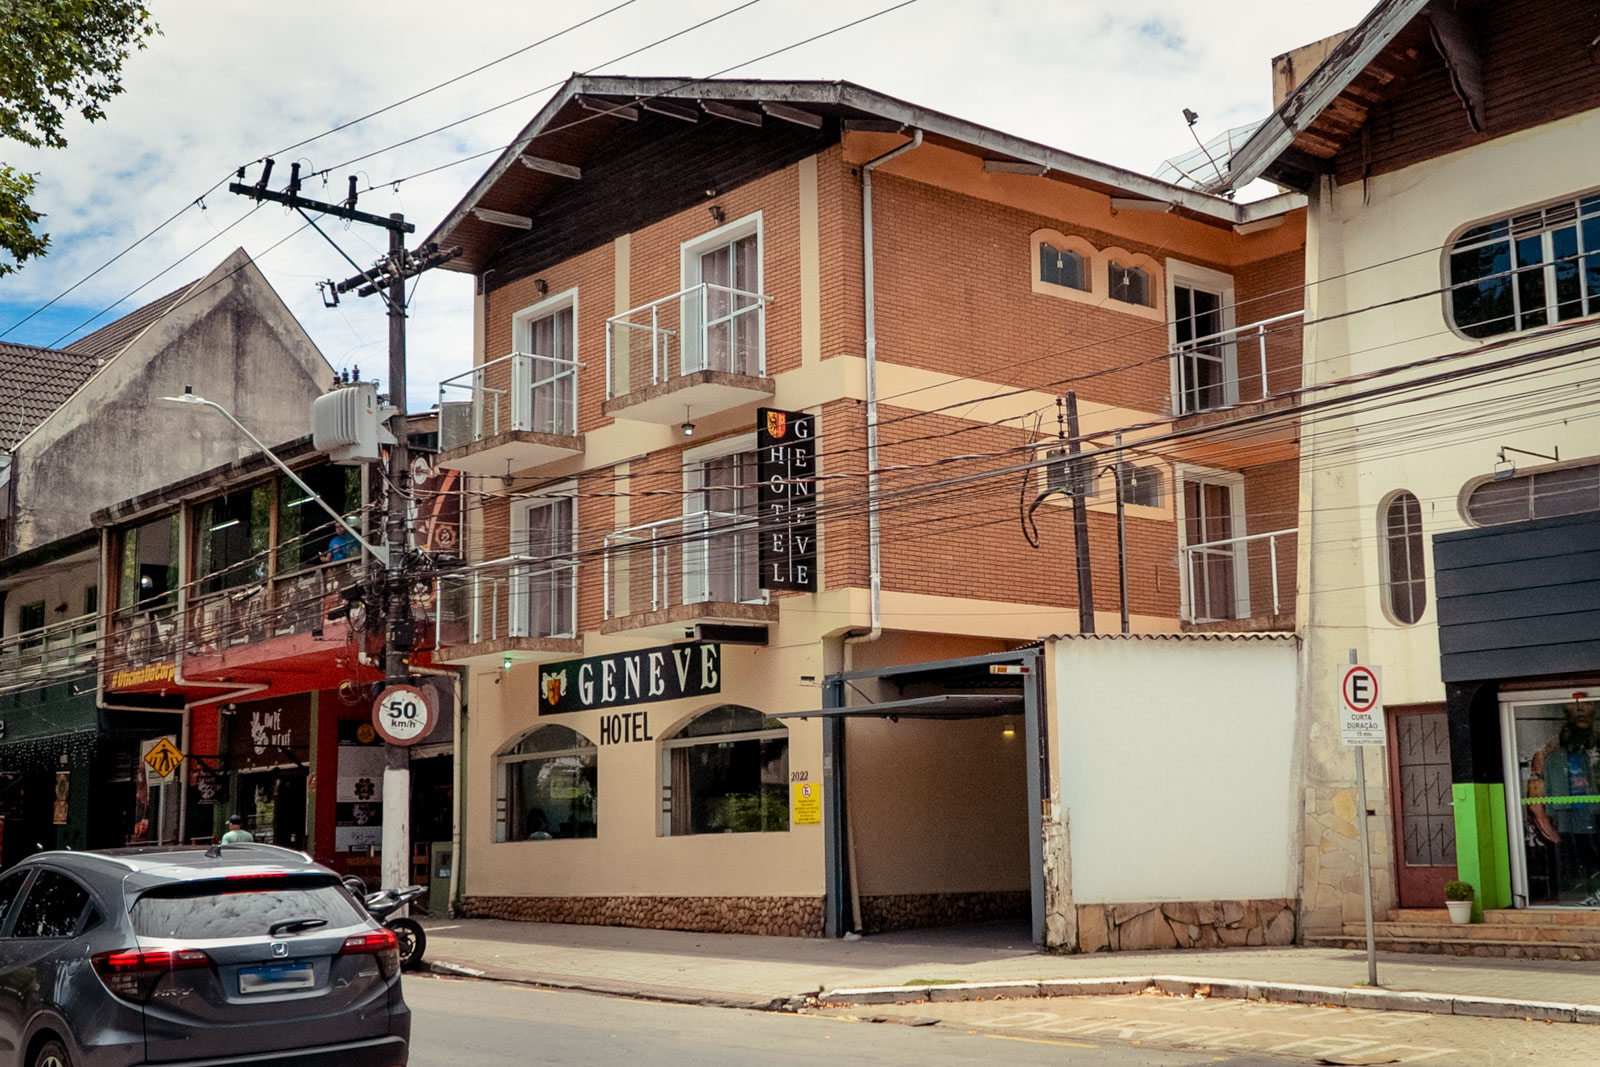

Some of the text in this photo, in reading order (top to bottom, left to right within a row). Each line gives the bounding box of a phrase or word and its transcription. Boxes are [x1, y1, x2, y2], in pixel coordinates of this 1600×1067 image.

[770, 445, 785, 583] HOTEL
[577, 643, 718, 706] GENEVE
[1353, 675, 1369, 703] E
[387, 701, 417, 719] 50
[391, 719, 416, 728] km/h
[600, 711, 653, 746] HOTEL
[1347, 722, 1378, 731] DURAÇÃO
[791, 771, 808, 782] 2022
